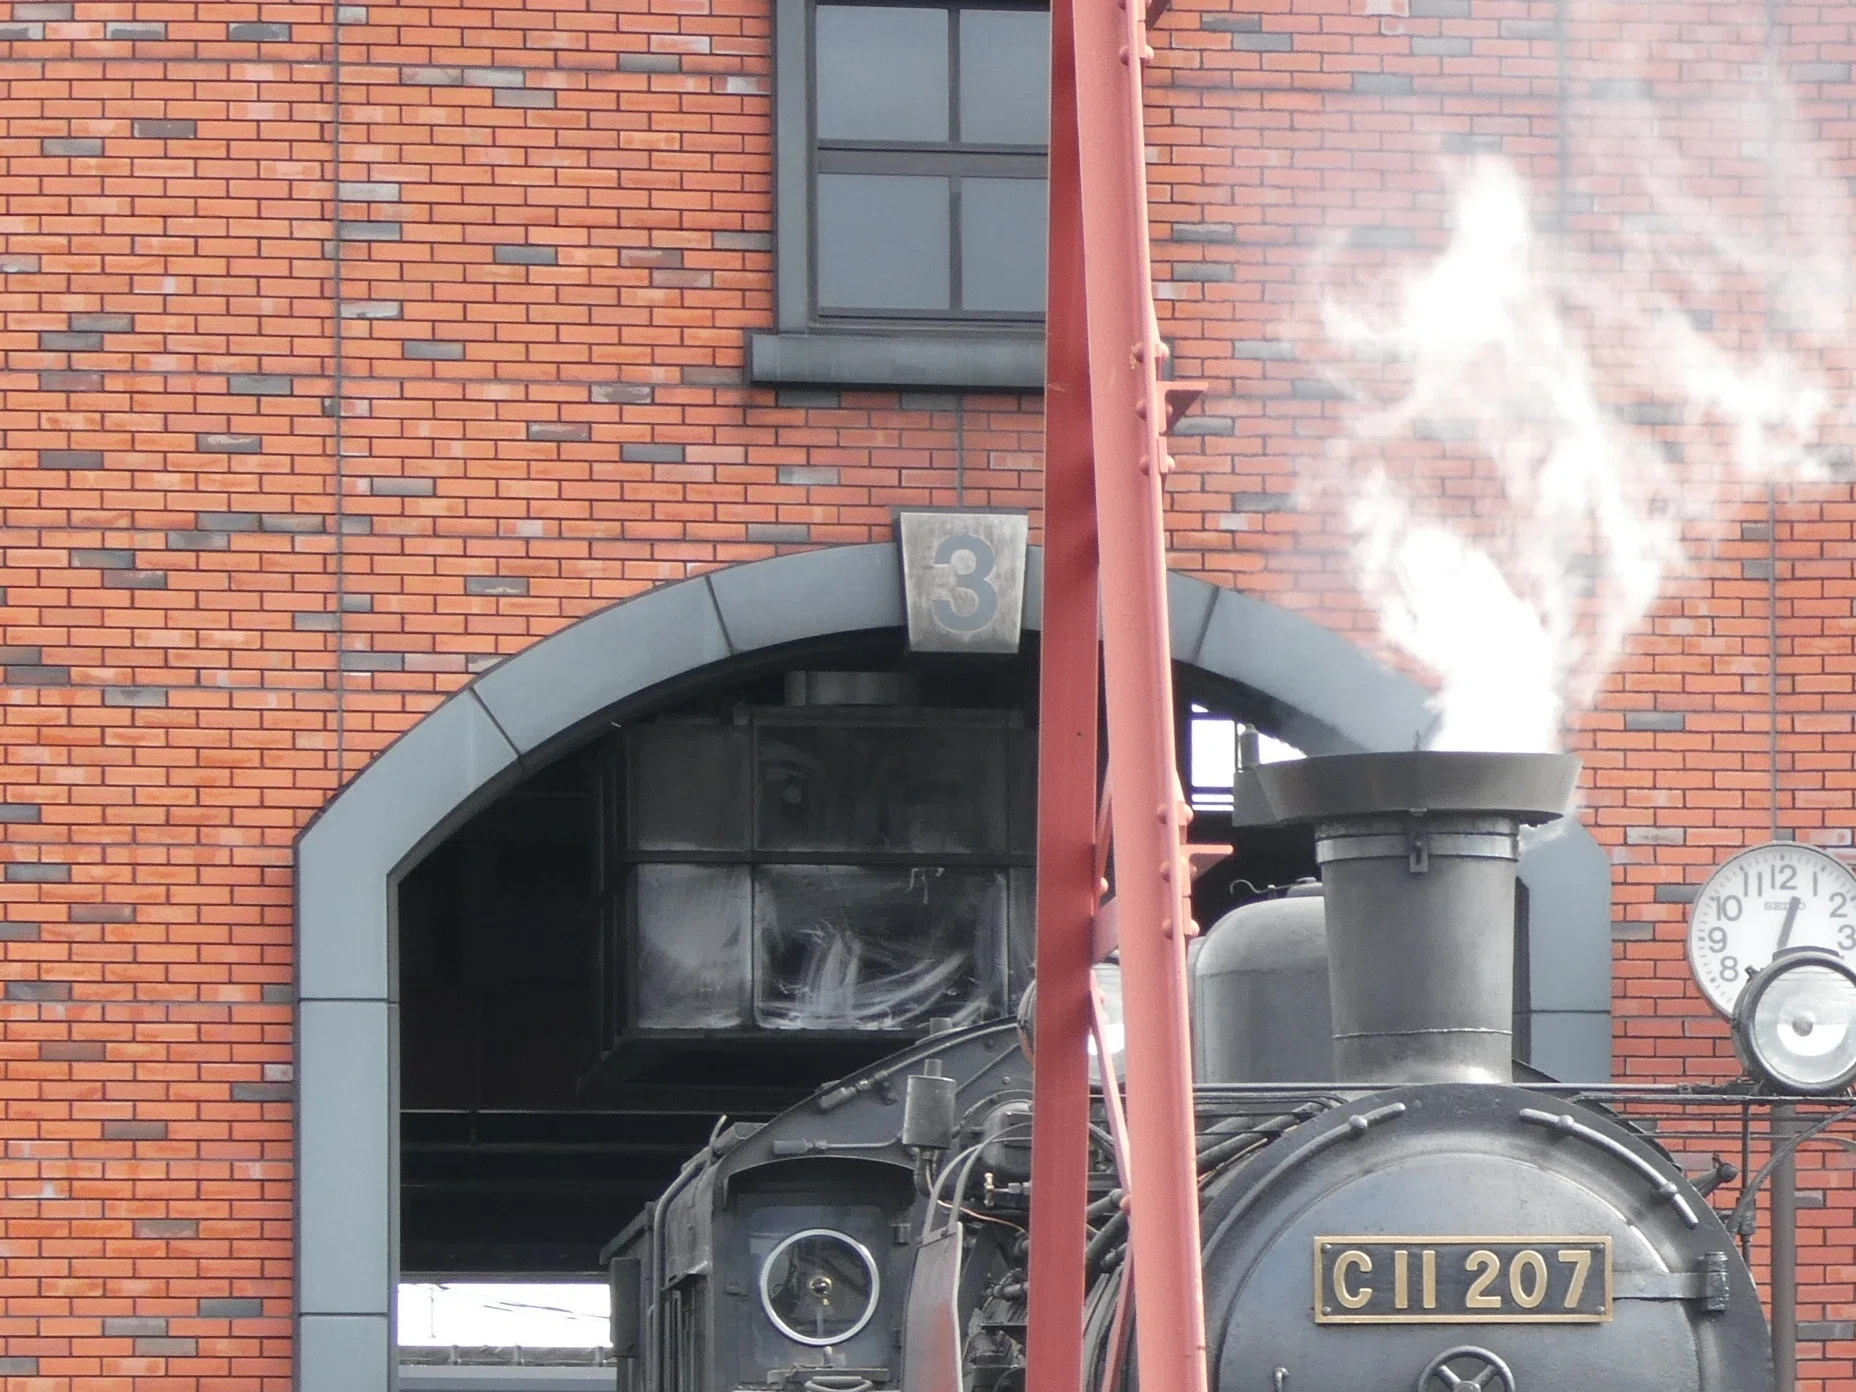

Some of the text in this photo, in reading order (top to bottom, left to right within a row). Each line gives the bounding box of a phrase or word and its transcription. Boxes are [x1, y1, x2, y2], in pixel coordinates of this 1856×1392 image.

[932, 534, 998, 632] 3
[1771, 864, 1797, 890] 12
[1716, 895, 1743, 921] 10
[1764, 902, 1806, 911] SEIO
[1828, 892, 1848, 918] 2
[1708, 926, 1727, 953] 9
[1836, 924, 1856, 950] 3
[1719, 956, 1739, 982] 8
[1465, 1250, 1591, 1309] 207
